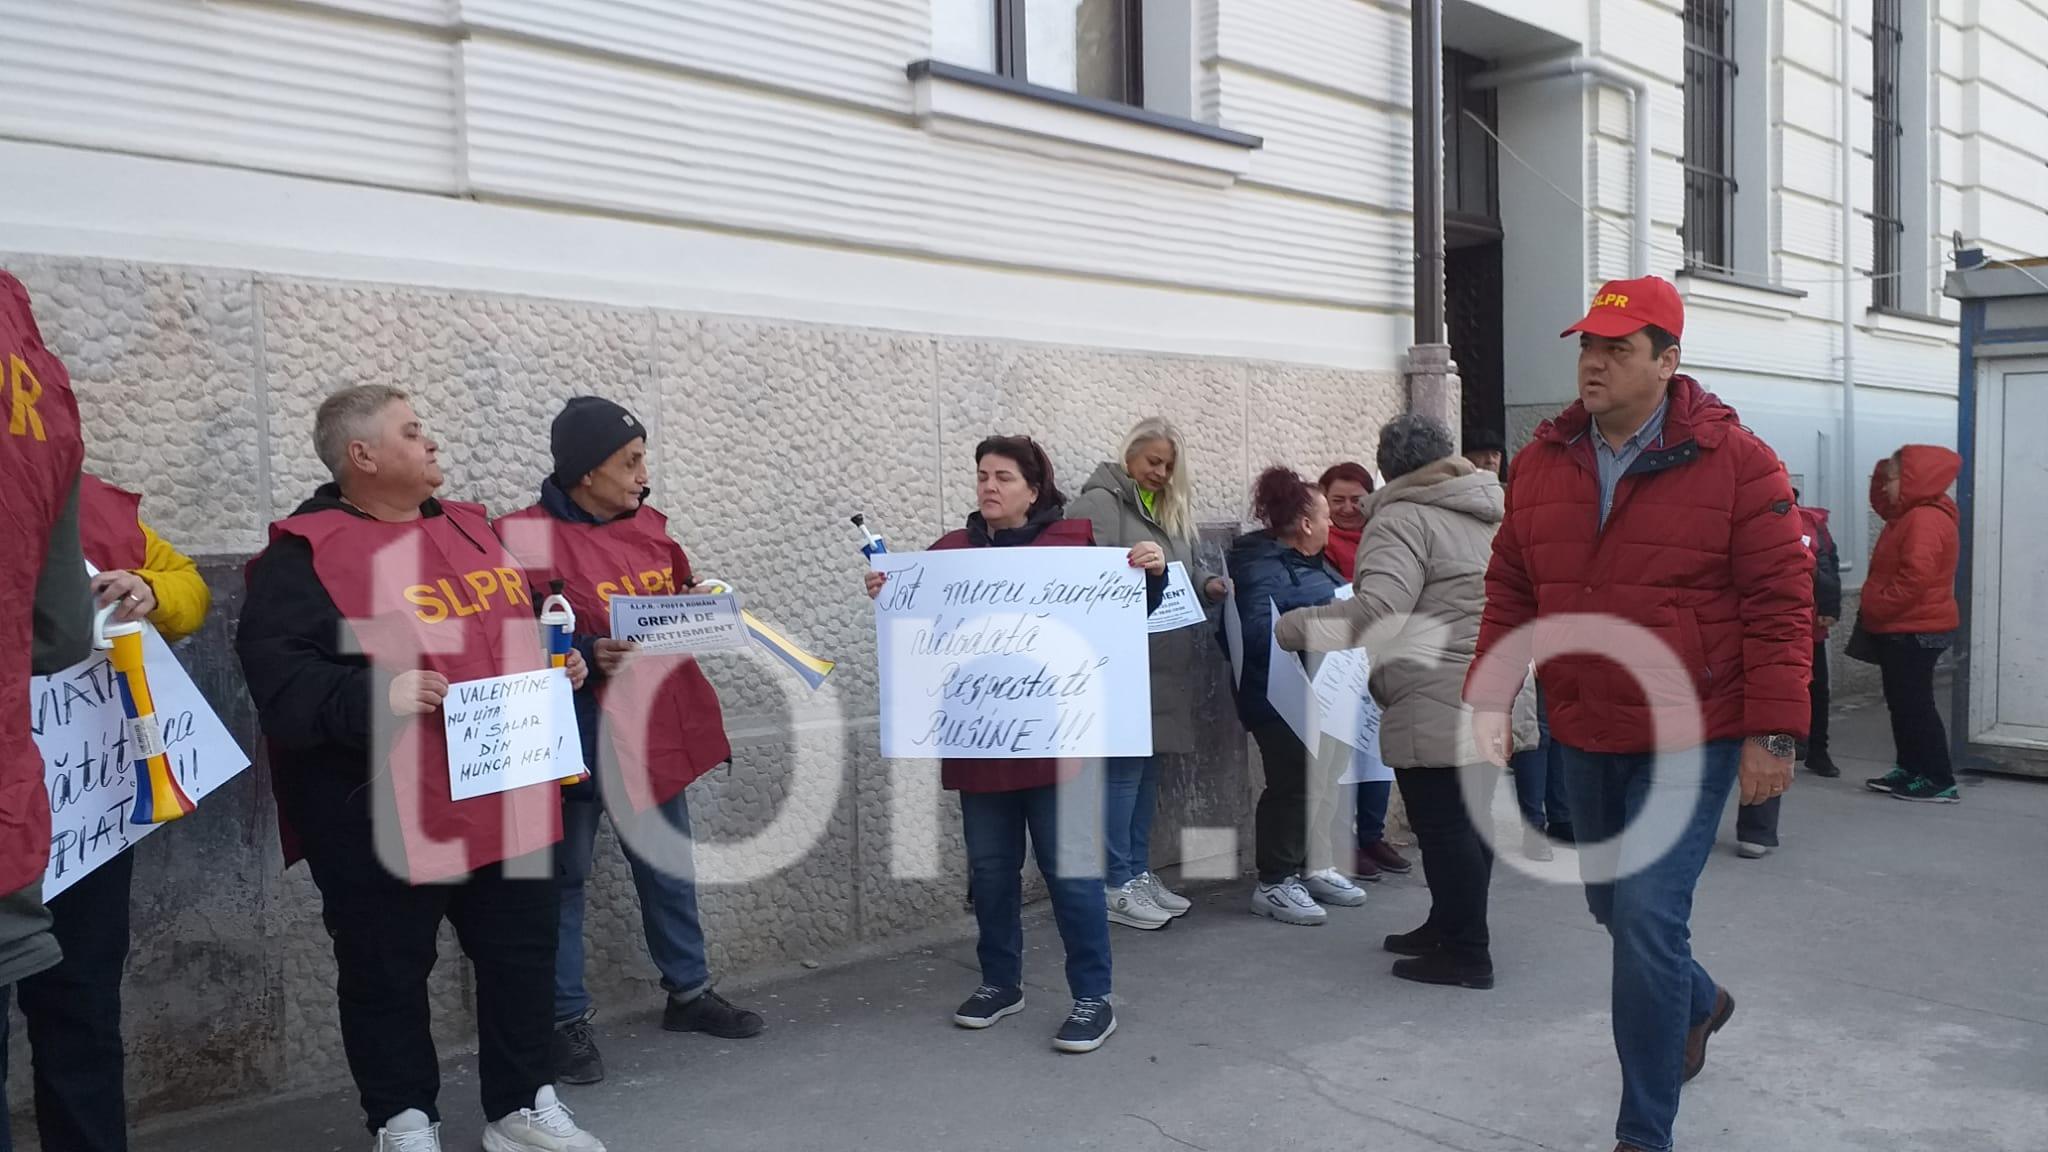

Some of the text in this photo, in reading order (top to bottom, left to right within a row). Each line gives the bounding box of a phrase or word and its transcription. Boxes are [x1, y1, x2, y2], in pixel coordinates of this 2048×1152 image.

[0, 352, 48, 442] R
[402, 567, 531, 625] SLPR
[879, 562, 925, 612] Tot
[626, 623, 736, 644] AVERTISMENT
[637, 611, 716, 627] GREVĂ DE
[459, 674, 552, 705] VALENTINE
[447, 711, 467, 728] NU
[463, 714, 542, 743] AI SALAR
[478, 738, 512, 758] DIN
[459, 754, 512, 783] MUNCA
